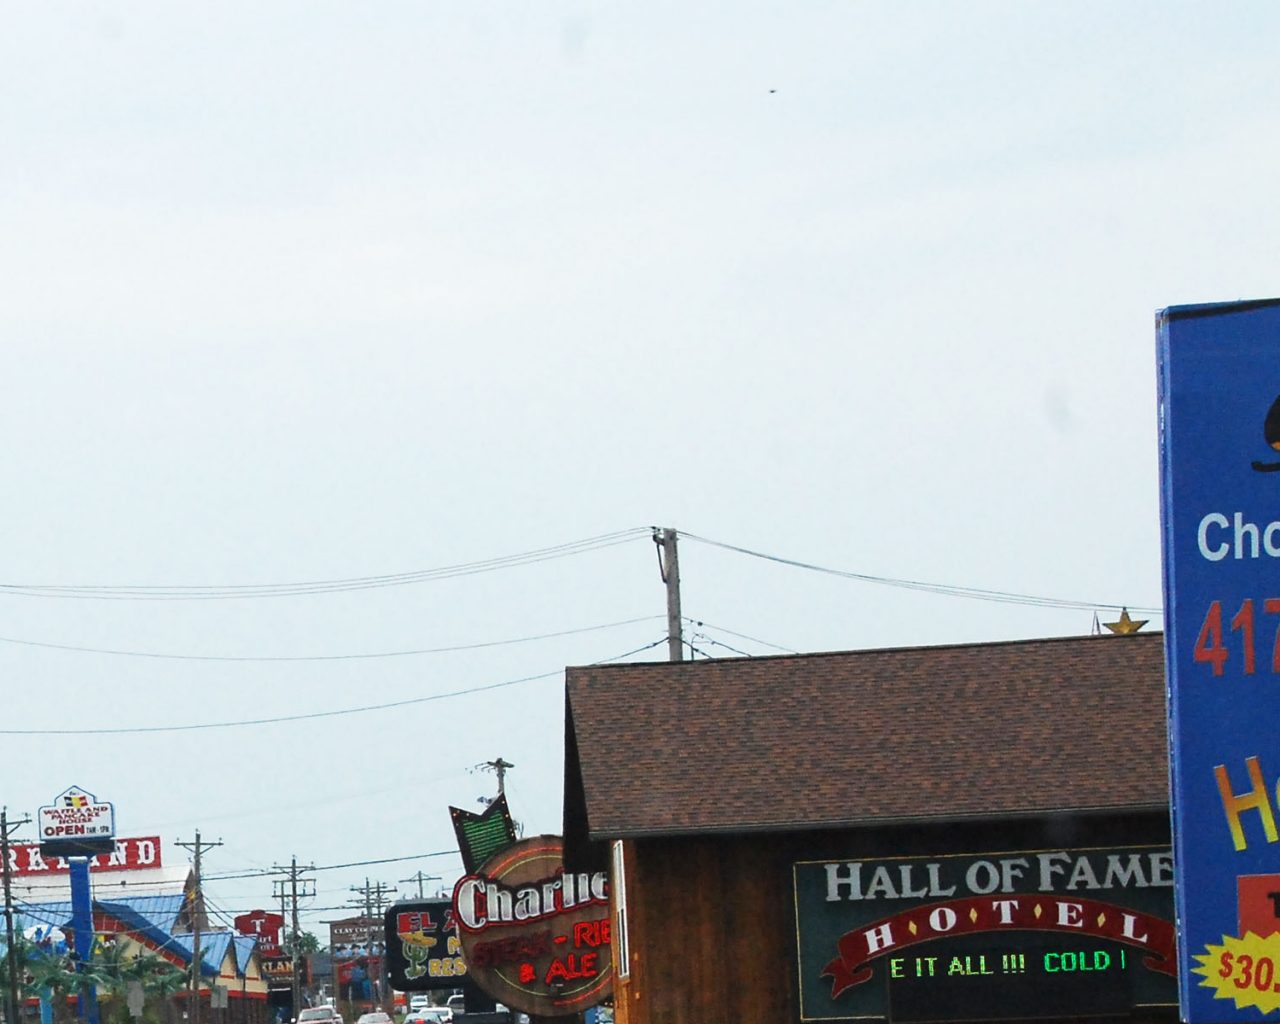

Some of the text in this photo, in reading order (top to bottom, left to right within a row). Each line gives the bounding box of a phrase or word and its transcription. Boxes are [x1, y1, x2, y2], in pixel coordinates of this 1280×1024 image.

[51, 812, 100, 820] PANCAKE
[85, 806, 109, 814] AND
[1214, 756, 1280, 851] H
[44, 825, 85, 837] OPEN
[824, 850, 1175, 901] HALL OF FAME
[863, 900, 1149, 955] HOTEL
[545, 952, 598, 985] ALE
[915, 956, 938, 978] IT
[947, 955, 994, 976] ALL
[1043, 950, 1110, 973] COLD
